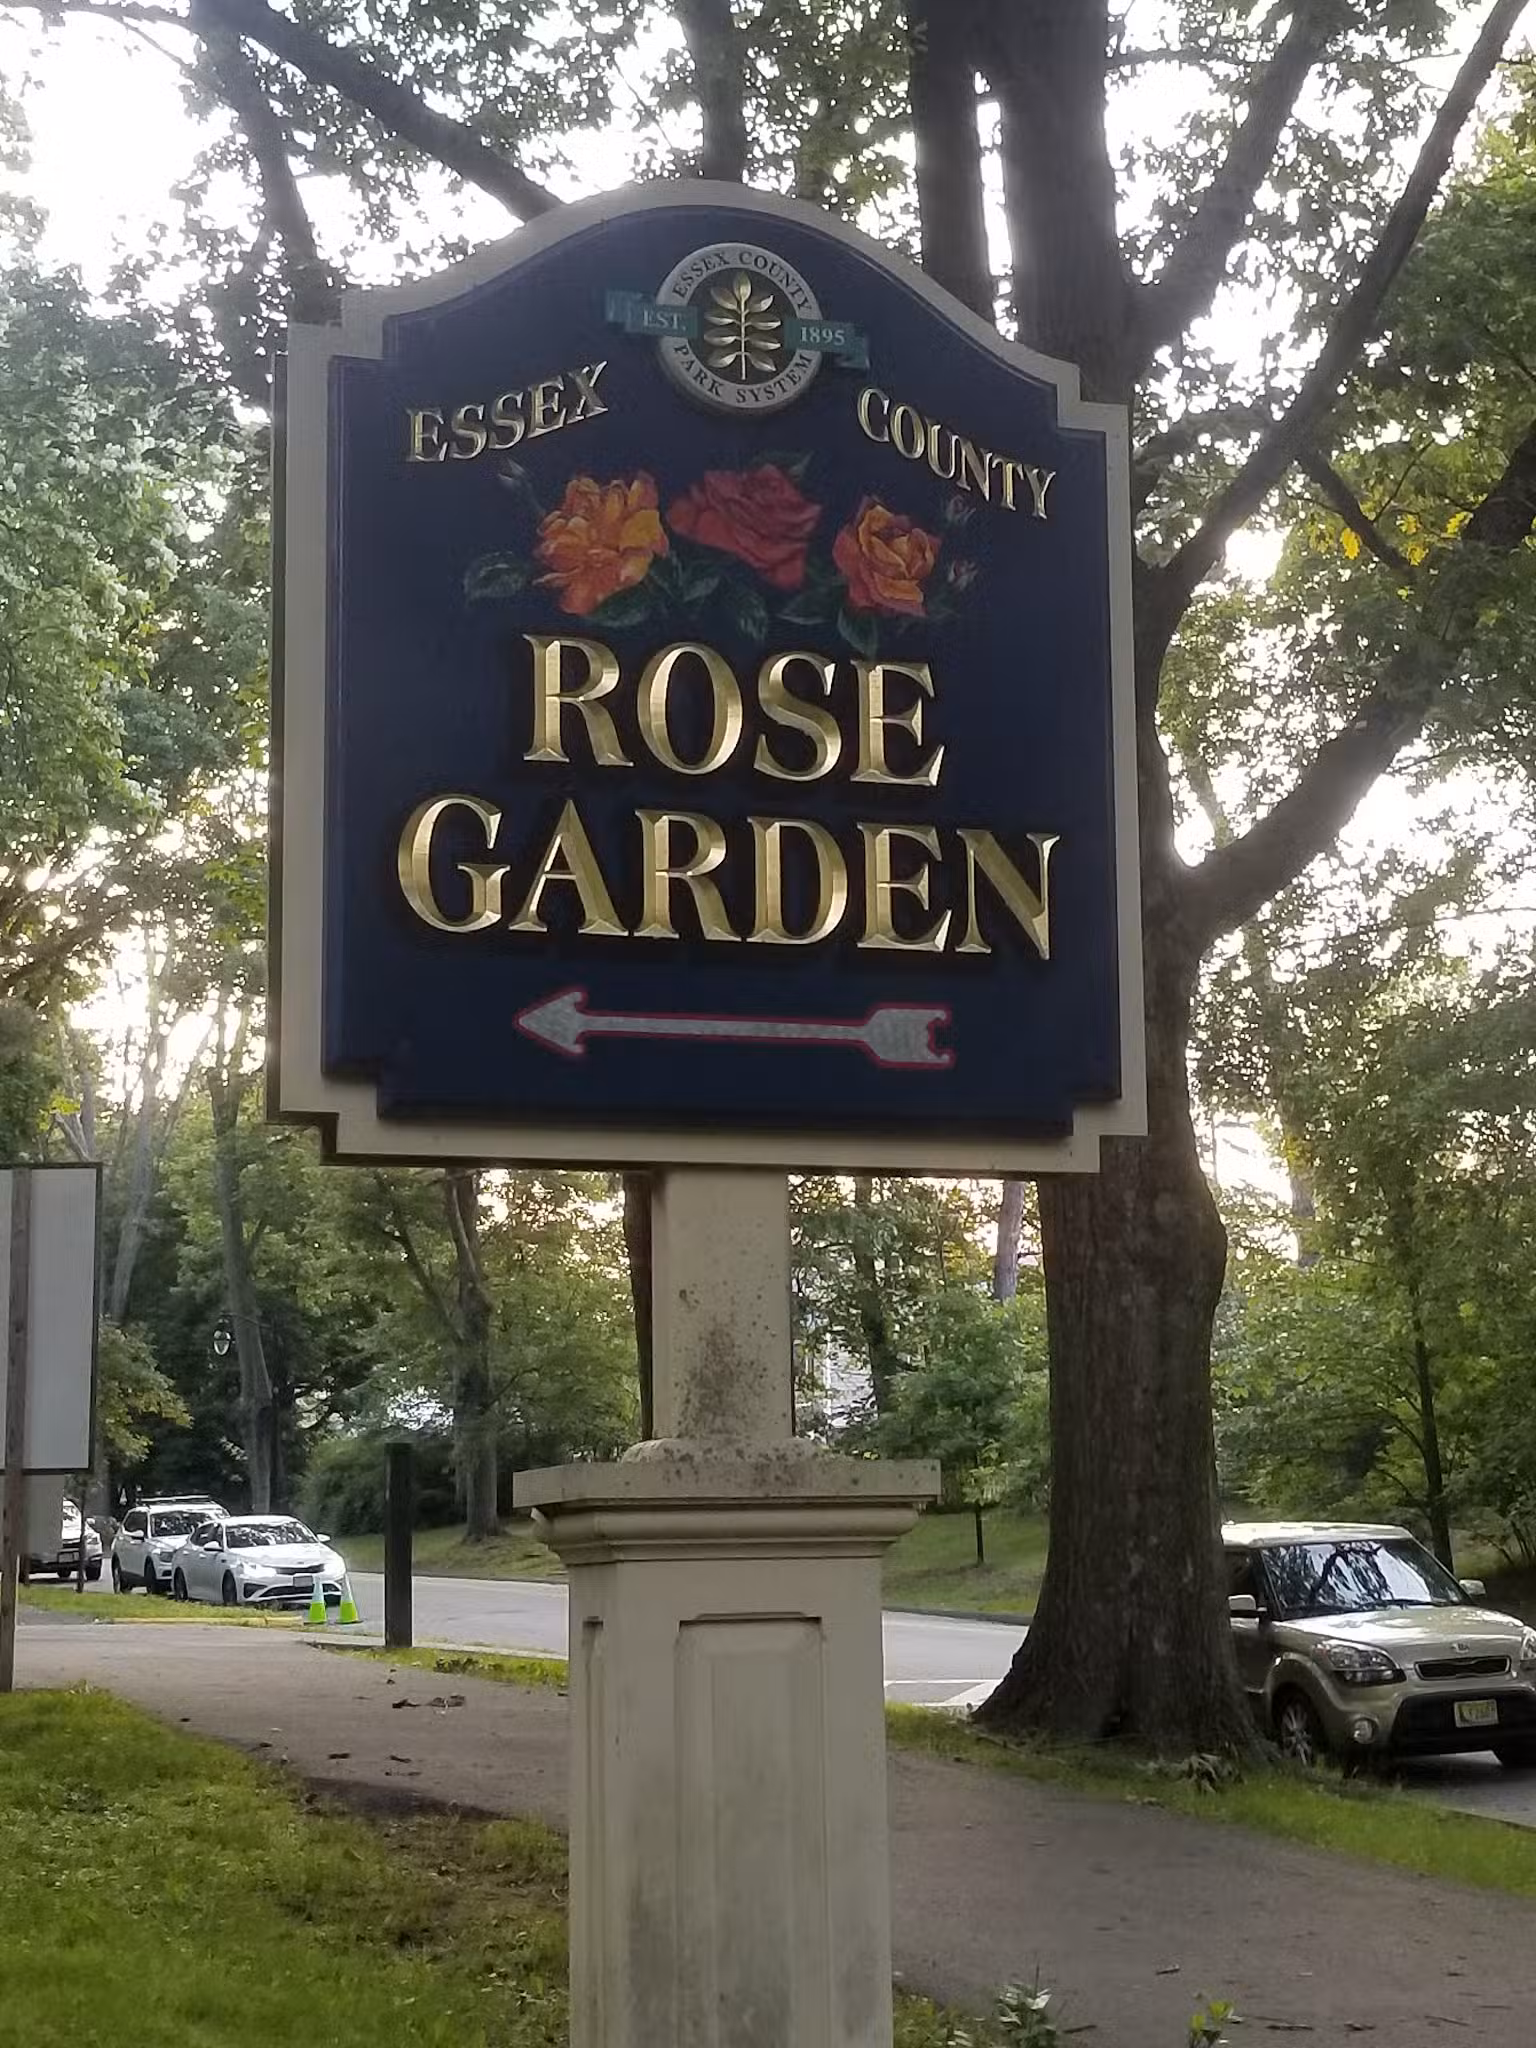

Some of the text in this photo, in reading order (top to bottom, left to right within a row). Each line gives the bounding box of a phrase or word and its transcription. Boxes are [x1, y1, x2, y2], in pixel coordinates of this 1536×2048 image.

[643, 309, 845, 346] EST. 1895
[672, 251, 812, 312] ESSEX COUNTY
[674, 344, 812, 403] PARK SYSTEM
[406, 361, 1057, 519] ESSEX COUNTY
[522, 633, 945, 787] ROSE
[397, 793, 1061, 961] GARDEN
